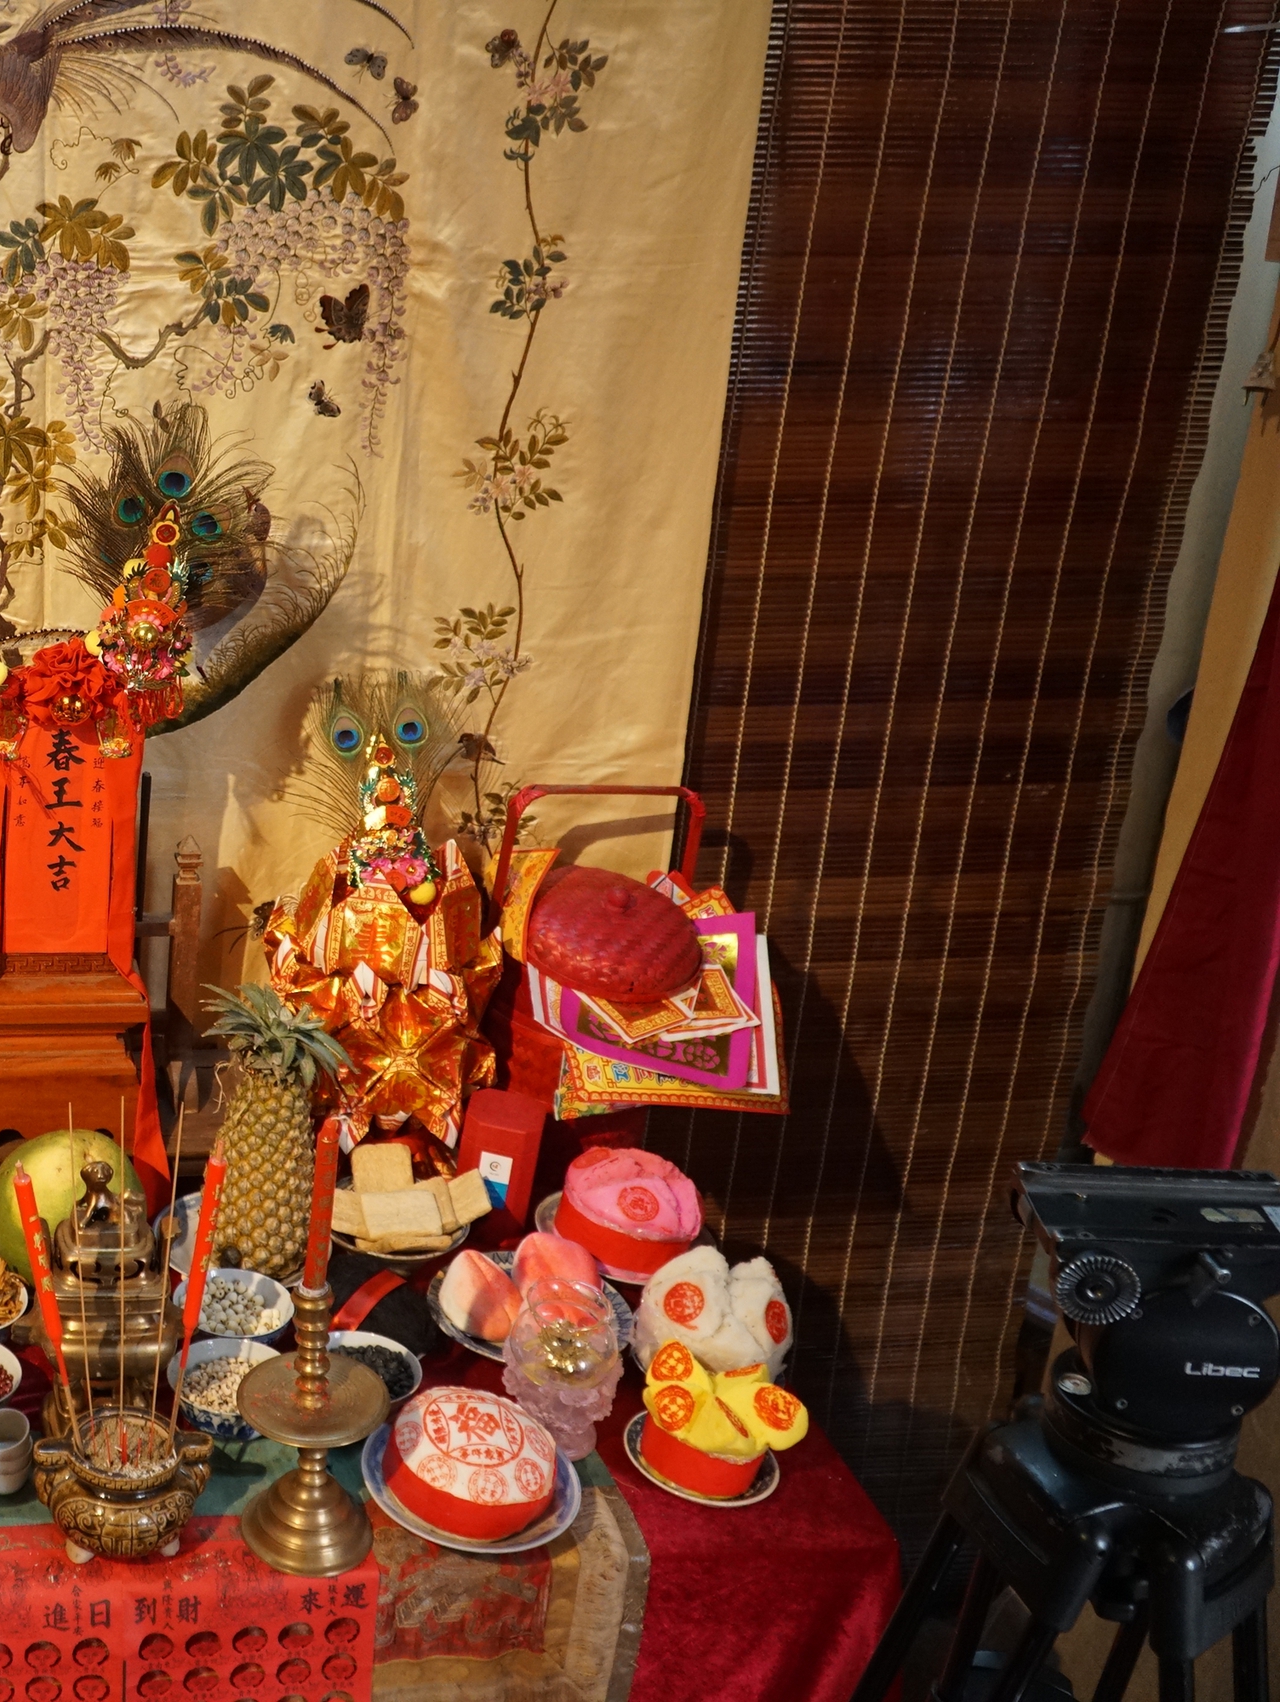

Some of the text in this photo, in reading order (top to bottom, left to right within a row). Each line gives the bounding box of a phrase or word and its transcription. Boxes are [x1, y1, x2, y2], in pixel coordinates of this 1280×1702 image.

[44, 729, 86, 891] 春王大吉
[91, 757, 106, 828] 迎春接福
[1185, 1361, 1261, 1379] Libec
